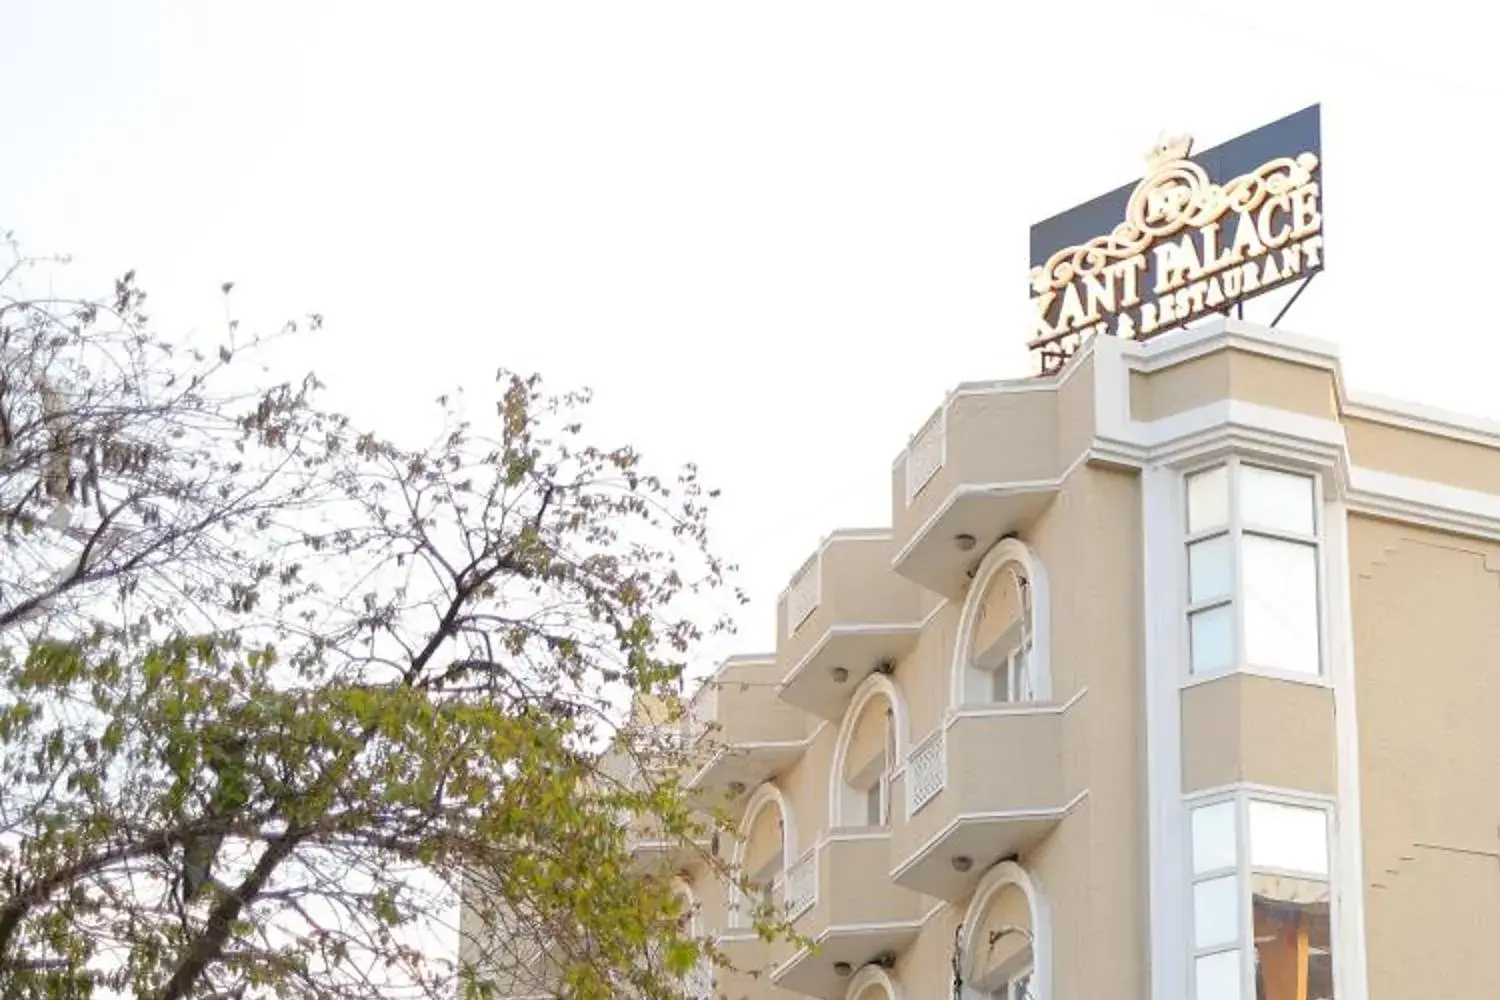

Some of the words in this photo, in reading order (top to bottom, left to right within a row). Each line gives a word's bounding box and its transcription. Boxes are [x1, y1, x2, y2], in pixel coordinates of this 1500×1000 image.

[1030, 255, 1146, 345] KANT
[1152, 183, 1321, 293] PALACE
[1140, 235, 1322, 334] RESTAURANT
